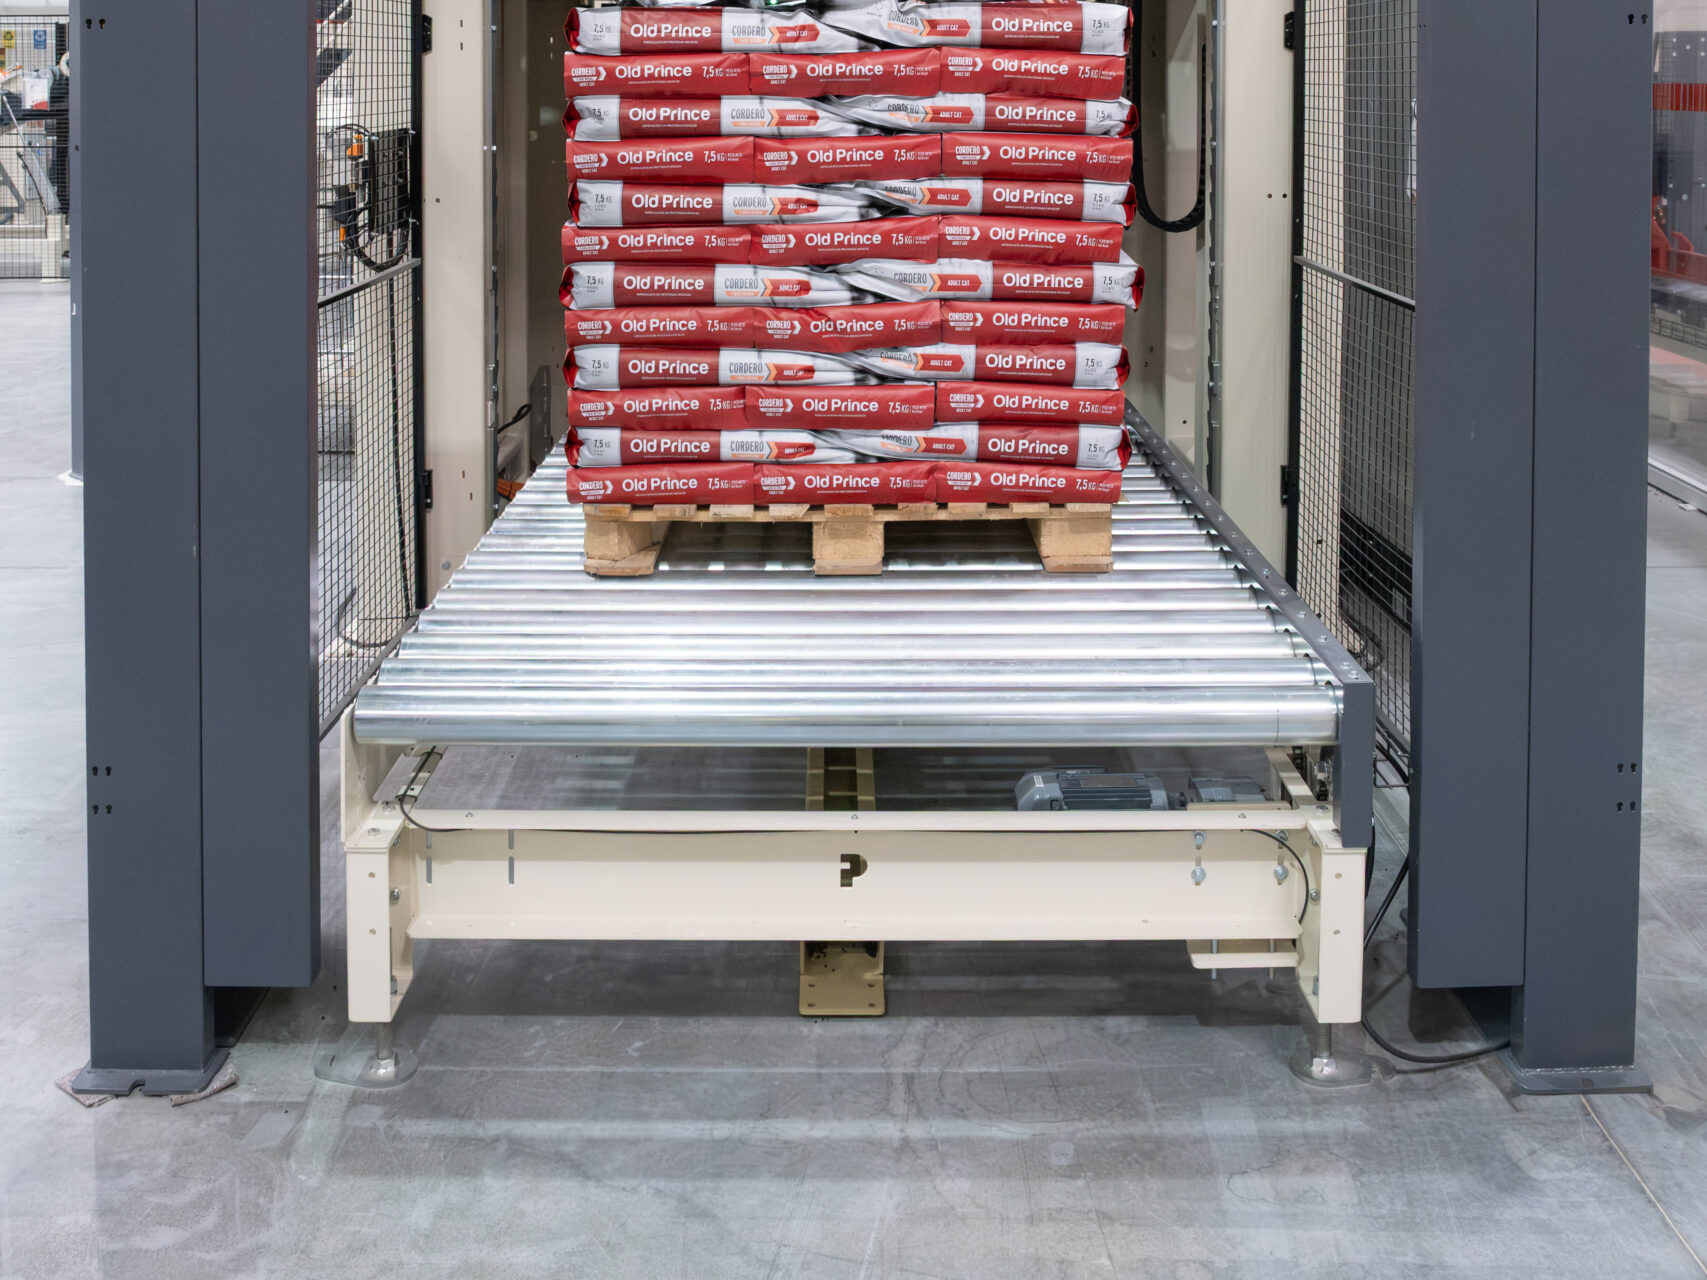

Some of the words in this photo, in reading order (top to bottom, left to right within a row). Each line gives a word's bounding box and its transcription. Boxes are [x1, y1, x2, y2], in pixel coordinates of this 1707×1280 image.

[630, 23, 658, 37] Old
[661, 23, 711, 37] Prince
[732, 26, 766, 37] CORDERO
[992, 17, 1019, 31] Old
[1022, 18, 1073, 32] Prince
[948, 57, 972, 66] CORDERO
[992, 58, 1019, 71] Old
[1021, 60, 1068, 75] Prince
[572, 66, 596, 76] CORDERO
[615, 66, 642, 79] Old
[644, 64, 692, 78] Prince
[762, 65, 788, 74] CORDERO
[806, 64, 832, 77] Old
[836, 63, 884, 76] Prince
[628, 107, 657, 121] Old
[659, 107, 711, 121] Prince
[731, 109, 765, 120] CORDERO
[995, 105, 1023, 119] Old
[1025, 106, 1076, 121] Prince
[617, 151, 642, 165] Old
[646, 150, 694, 163] Prince
[764, 151, 788, 160] CORDERO
[807, 149, 833, 163] Old
[836, 148, 884, 162] Prince
[956, 146, 980, 155] CORDERO
[1000, 145, 1026, 159] Old
[1028, 146, 1076, 161] Prince
[574, 154, 598, 164] CORDERO
[632, 193, 659, 208] Old
[662, 194, 713, 208] Prince
[733, 197, 766, 208] CORDERO
[993, 187, 1020, 202] Old
[1023, 189, 1074, 205] Prince
[946, 226, 970, 236] CORDERO
[989, 226, 1016, 240] Old
[1018, 227, 1066, 243] Prince
[574, 236, 599, 246] CORDERO
[618, 234, 644, 247] Old
[647, 233, 694, 246] Prince
[762, 234, 786, 244] CORDERO
[805, 233, 831, 246] Old
[834, 232, 881, 245] Prince
[623, 275, 651, 289] Old
[654, 275, 704, 290] Prince
[724, 278, 758, 289] CORDERO
[894, 273, 927, 284] CORDERO
[1003, 272, 1030, 287] Old
[1033, 273, 1084, 288] Prince
[948, 312, 973, 321] CORDERO
[992, 312, 1018, 326] Old
[1021, 313, 1068, 327] Prince
[578, 321, 602, 330] CORDERO
[621, 319, 646, 332] Old
[650, 318, 697, 331] Prince
[766, 320, 790, 330] CORDERO
[810, 319, 834, 333] Old
[836, 319, 884, 332] Prince
[628, 359, 656, 373] Old
[659, 359, 709, 374] Prince
[729, 362, 762, 374] CORDERO
[985, 353, 1013, 368] Old
[1016, 354, 1066, 370] Prince
[623, 399, 649, 413] Old
[652, 397, 699, 411] Prince
[759, 399, 783, 408] CORDERO
[802, 398, 828, 411] Old
[831, 399, 879, 412] Prince
[950, 394, 974, 403] CORDERO
[993, 394, 1019, 408] Old
[1022, 395, 1069, 410] Prince
[580, 402, 604, 412] CORDERO
[630, 438, 657, 452] Old
[660, 437, 710, 453] Prince
[730, 442, 764, 452] CORDERO
[988, 438, 1015, 452] Old
[1018, 439, 1068, 455] Prince
[761, 477, 785, 486] CORDERO
[804, 475, 830, 488] Old
[833, 475, 880, 487] Prince
[947, 472, 971, 481] CORDERO
[990, 472, 1016, 486] Old
[1019, 473, 1066, 488] Prince
[579, 481, 603, 490] CORDERO
[622, 478, 647, 492] Old
[650, 476, 698, 490] Prince
